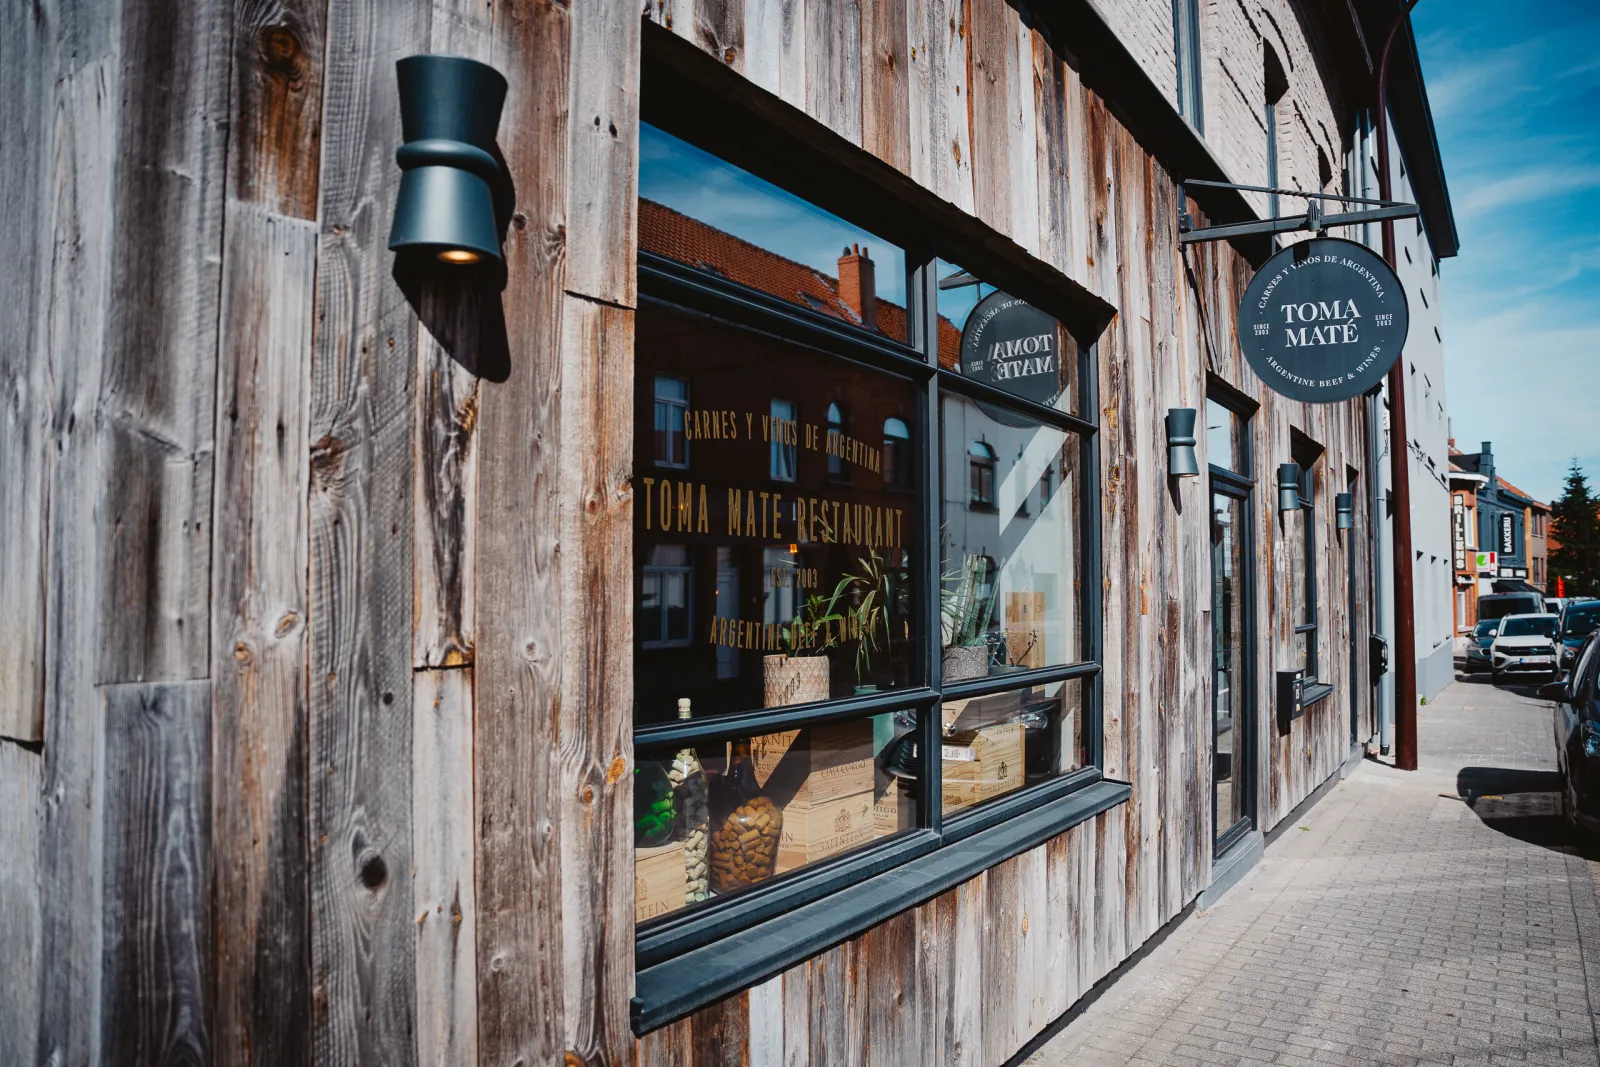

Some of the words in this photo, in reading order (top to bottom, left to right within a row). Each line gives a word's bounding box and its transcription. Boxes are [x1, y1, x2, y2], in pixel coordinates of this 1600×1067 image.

[1258, 274, 1283, 309] CARNES
[1283, 266, 1291, 276] Y
[1290, 255, 1321, 270] VINOS
[1324, 255, 1338, 264] DE
[1340, 257, 1385, 298] ARGENTINA
[1280, 298, 1362, 324] TOMA
[1375, 313, 1393, 321] SINCE
[1284, 318, 1359, 348] MATÉ
[1266, 355, 1315, 387] ARGENTINE
[1319, 376, 1344, 387] BEEF
[1347, 372, 1356, 380] &
[1355, 345, 1381, 374] WINES
[684, 410, 737, 441] CARNES
[745, 412, 753, 440] Y
[762, 414, 798, 447] VINOS
[805, 423, 819, 451] DE
[825, 429, 881, 474] ARGENTINA
[643, 477, 709, 534] TOMA
[728, 487, 782, 539] MATE
[797, 496, 903, 549] RESTAURANT
[796, 568, 818, 589] 2003
[709, 615, 783, 650] ARGENTINE
